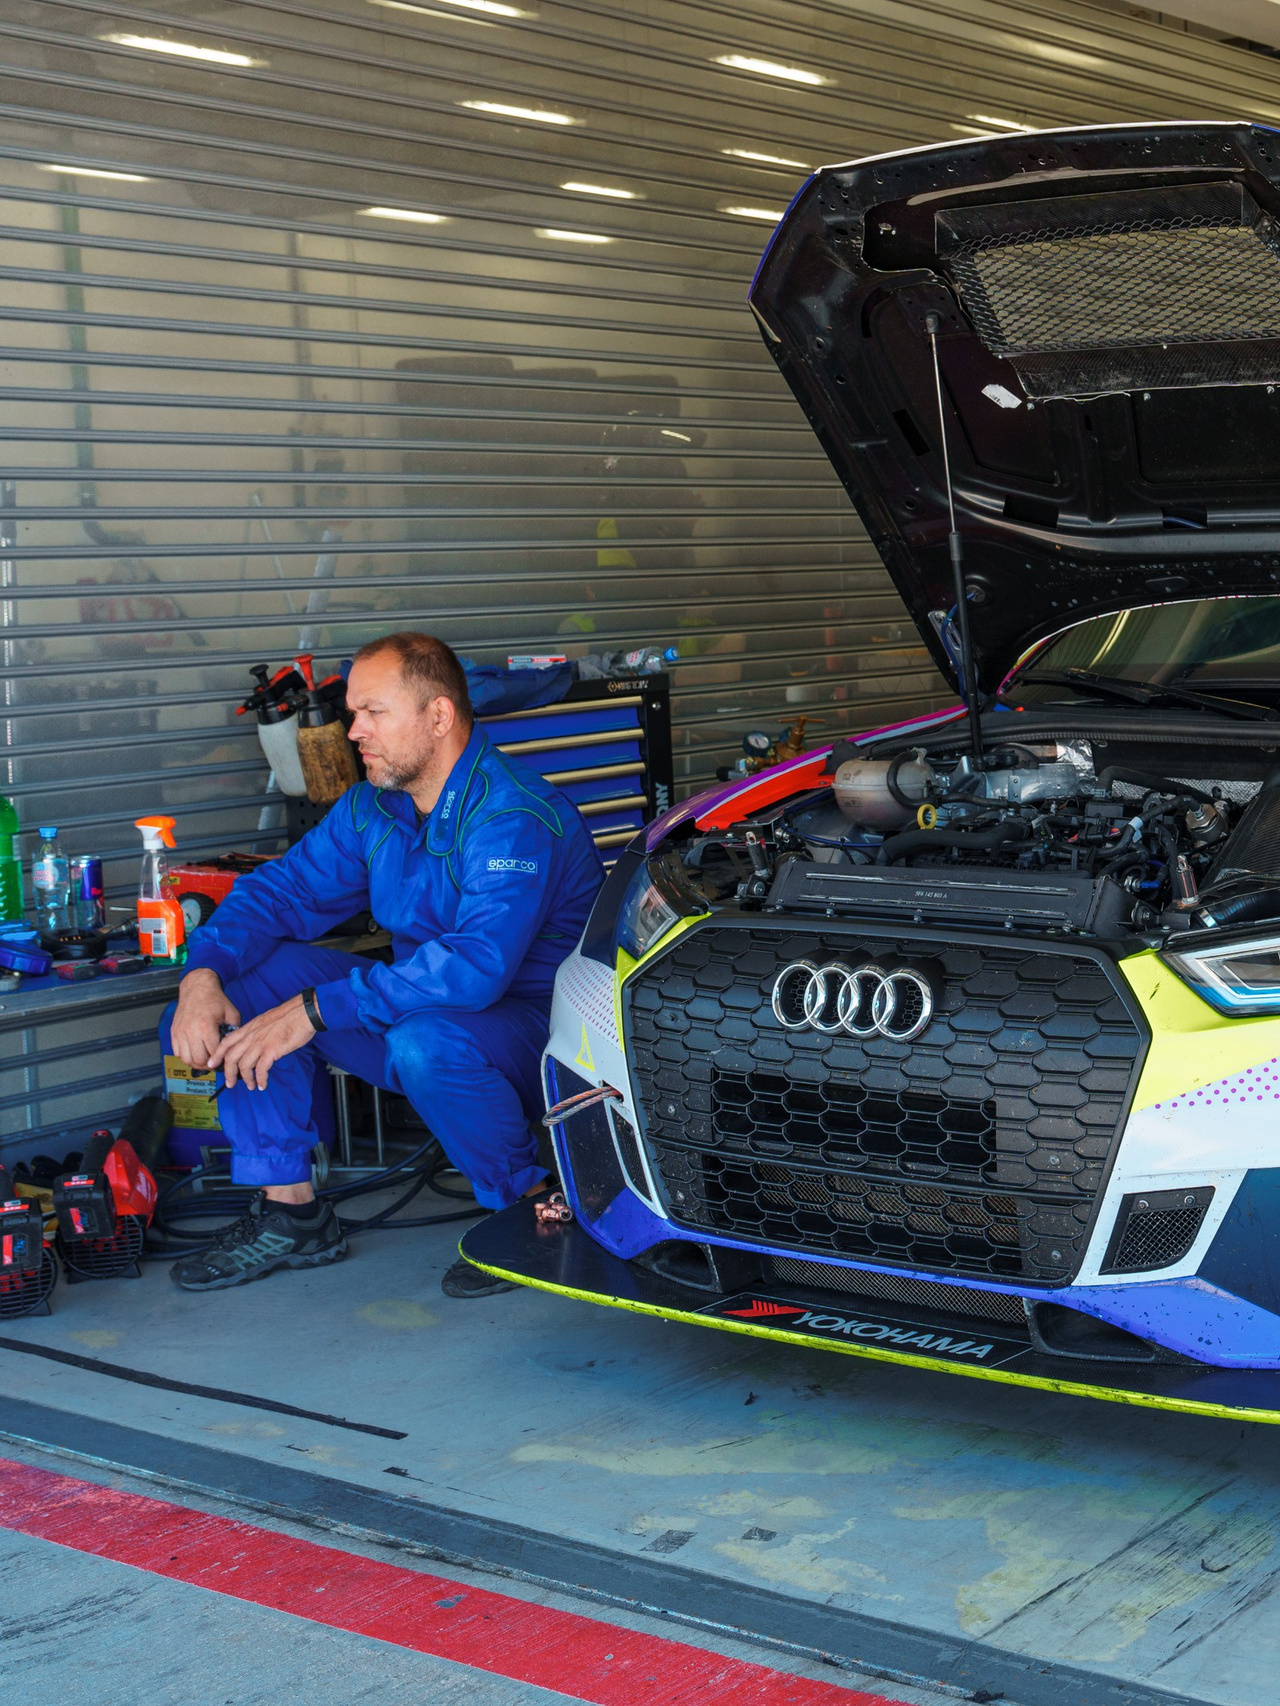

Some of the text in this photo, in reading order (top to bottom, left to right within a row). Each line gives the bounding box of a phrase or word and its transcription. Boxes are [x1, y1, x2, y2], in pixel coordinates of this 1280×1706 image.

[441, 790, 456, 819] sparco
[488, 858, 536, 872] sparco
[792, 1311, 994, 1359] YOKOHAMA
